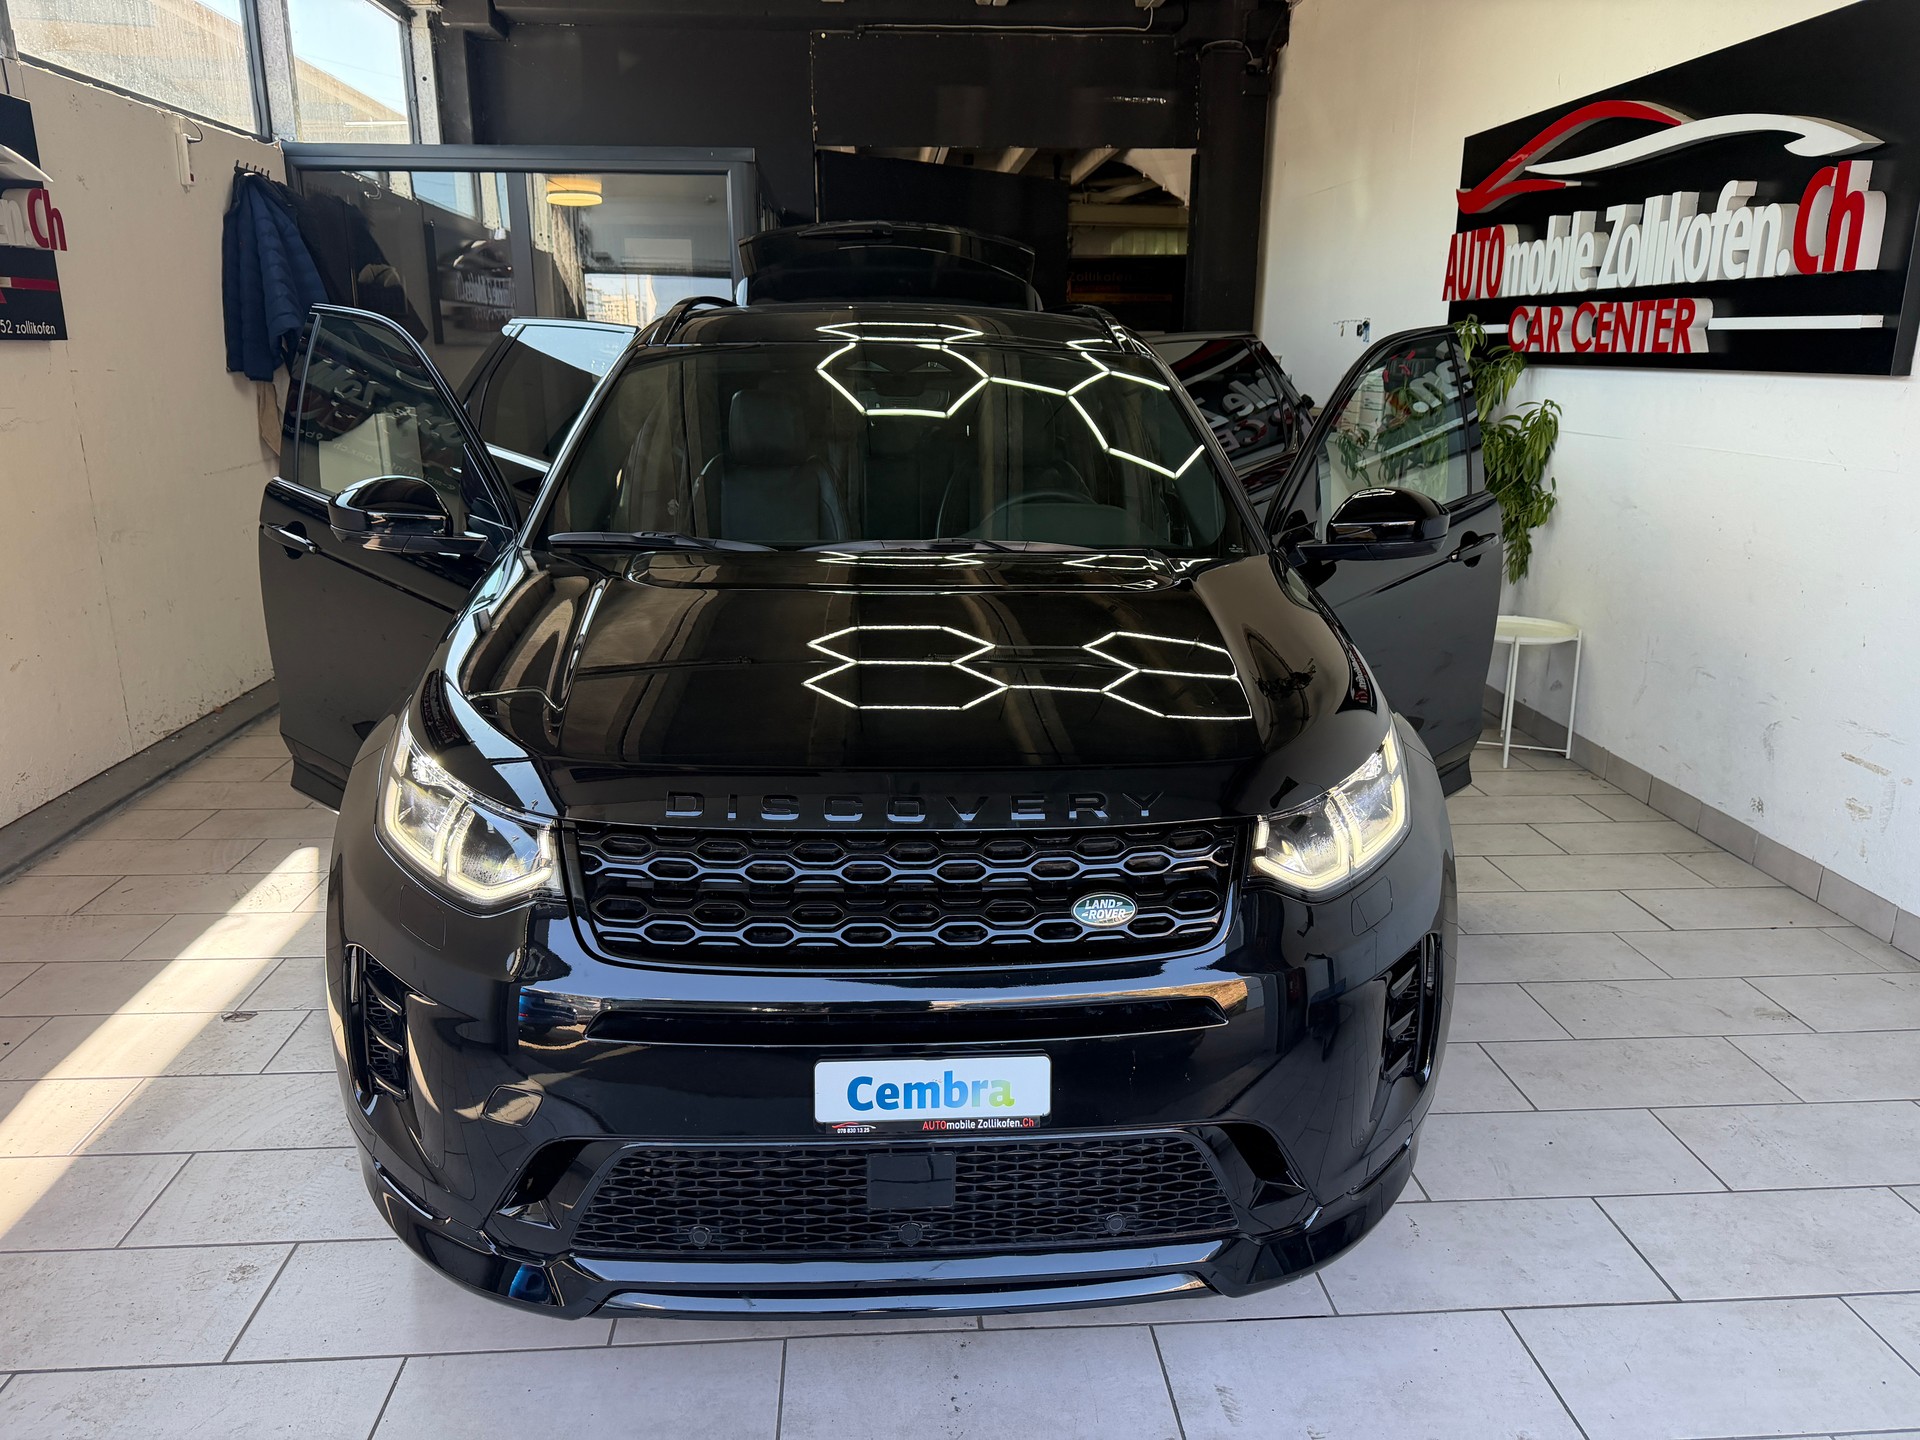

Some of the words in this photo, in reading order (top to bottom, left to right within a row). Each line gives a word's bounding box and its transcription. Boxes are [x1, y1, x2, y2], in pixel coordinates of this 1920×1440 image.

[1443, 211, 1600, 302] AUTOmobile
[1597, 160, 1875, 291] Zollikofen.Ch
[15, 320, 57, 335] zollikofen
[1508, 305, 1565, 353] CAR
[1571, 298, 1700, 353] CENTER
[665, 790, 1165, 822] DISCOVERY
[1085, 899, 1116, 909] LAND
[1088, 908, 1126, 920] ROVER
[847, 1070, 1015, 1112] Cembra
[922, 1119, 976, 1130] AUTOmobile
[977, 1117, 1035, 1129] Zollikofen.Ch
